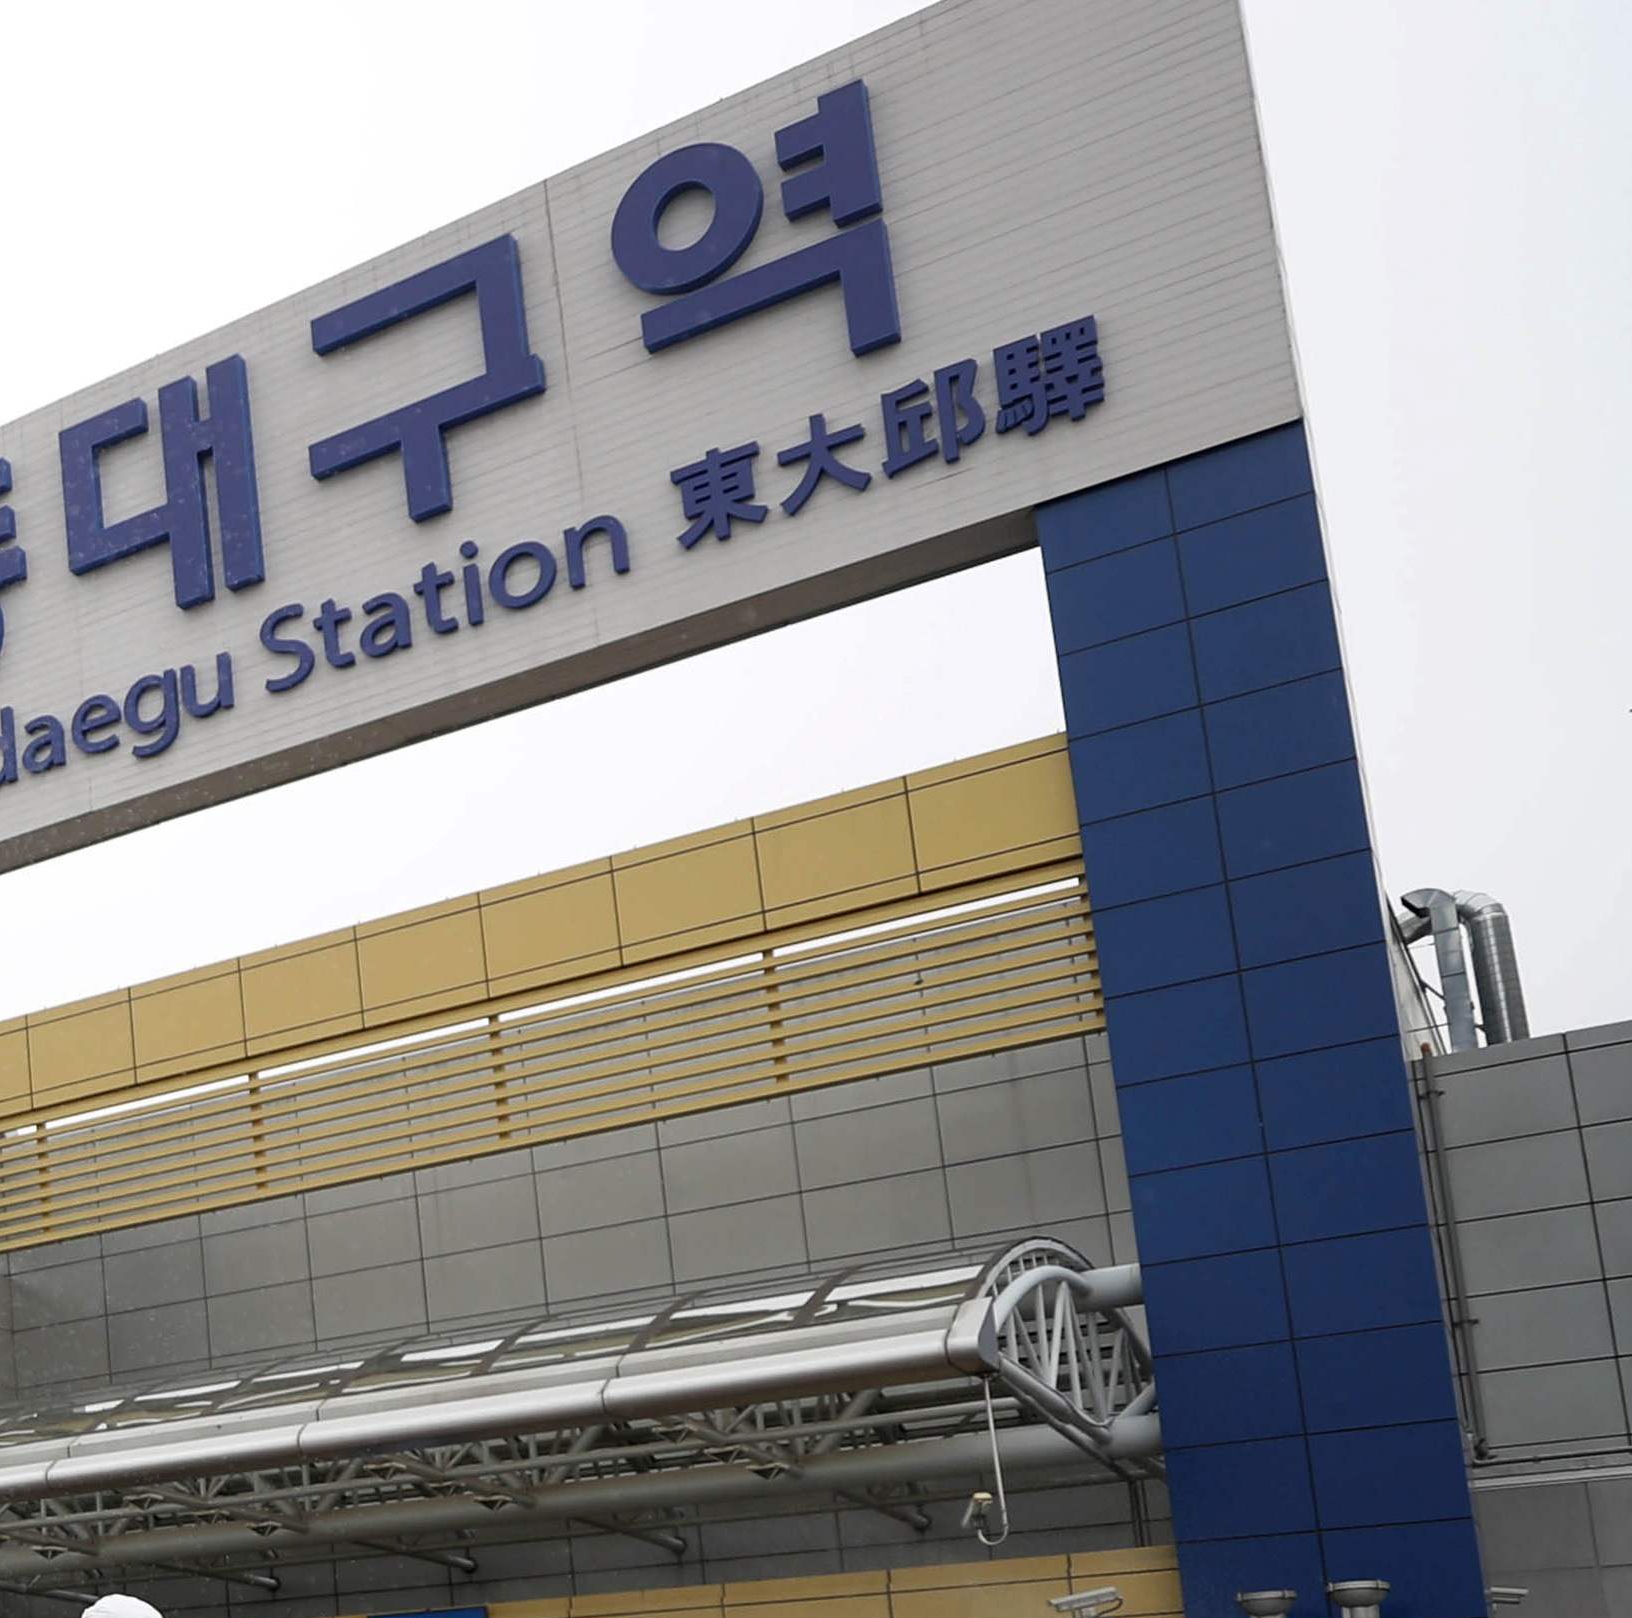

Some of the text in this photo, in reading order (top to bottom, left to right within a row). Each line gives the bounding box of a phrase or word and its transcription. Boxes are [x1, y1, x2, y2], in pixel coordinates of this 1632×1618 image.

[669, 316, 1108, 550] 東大邱驛
[263, 511, 631, 693] Station
